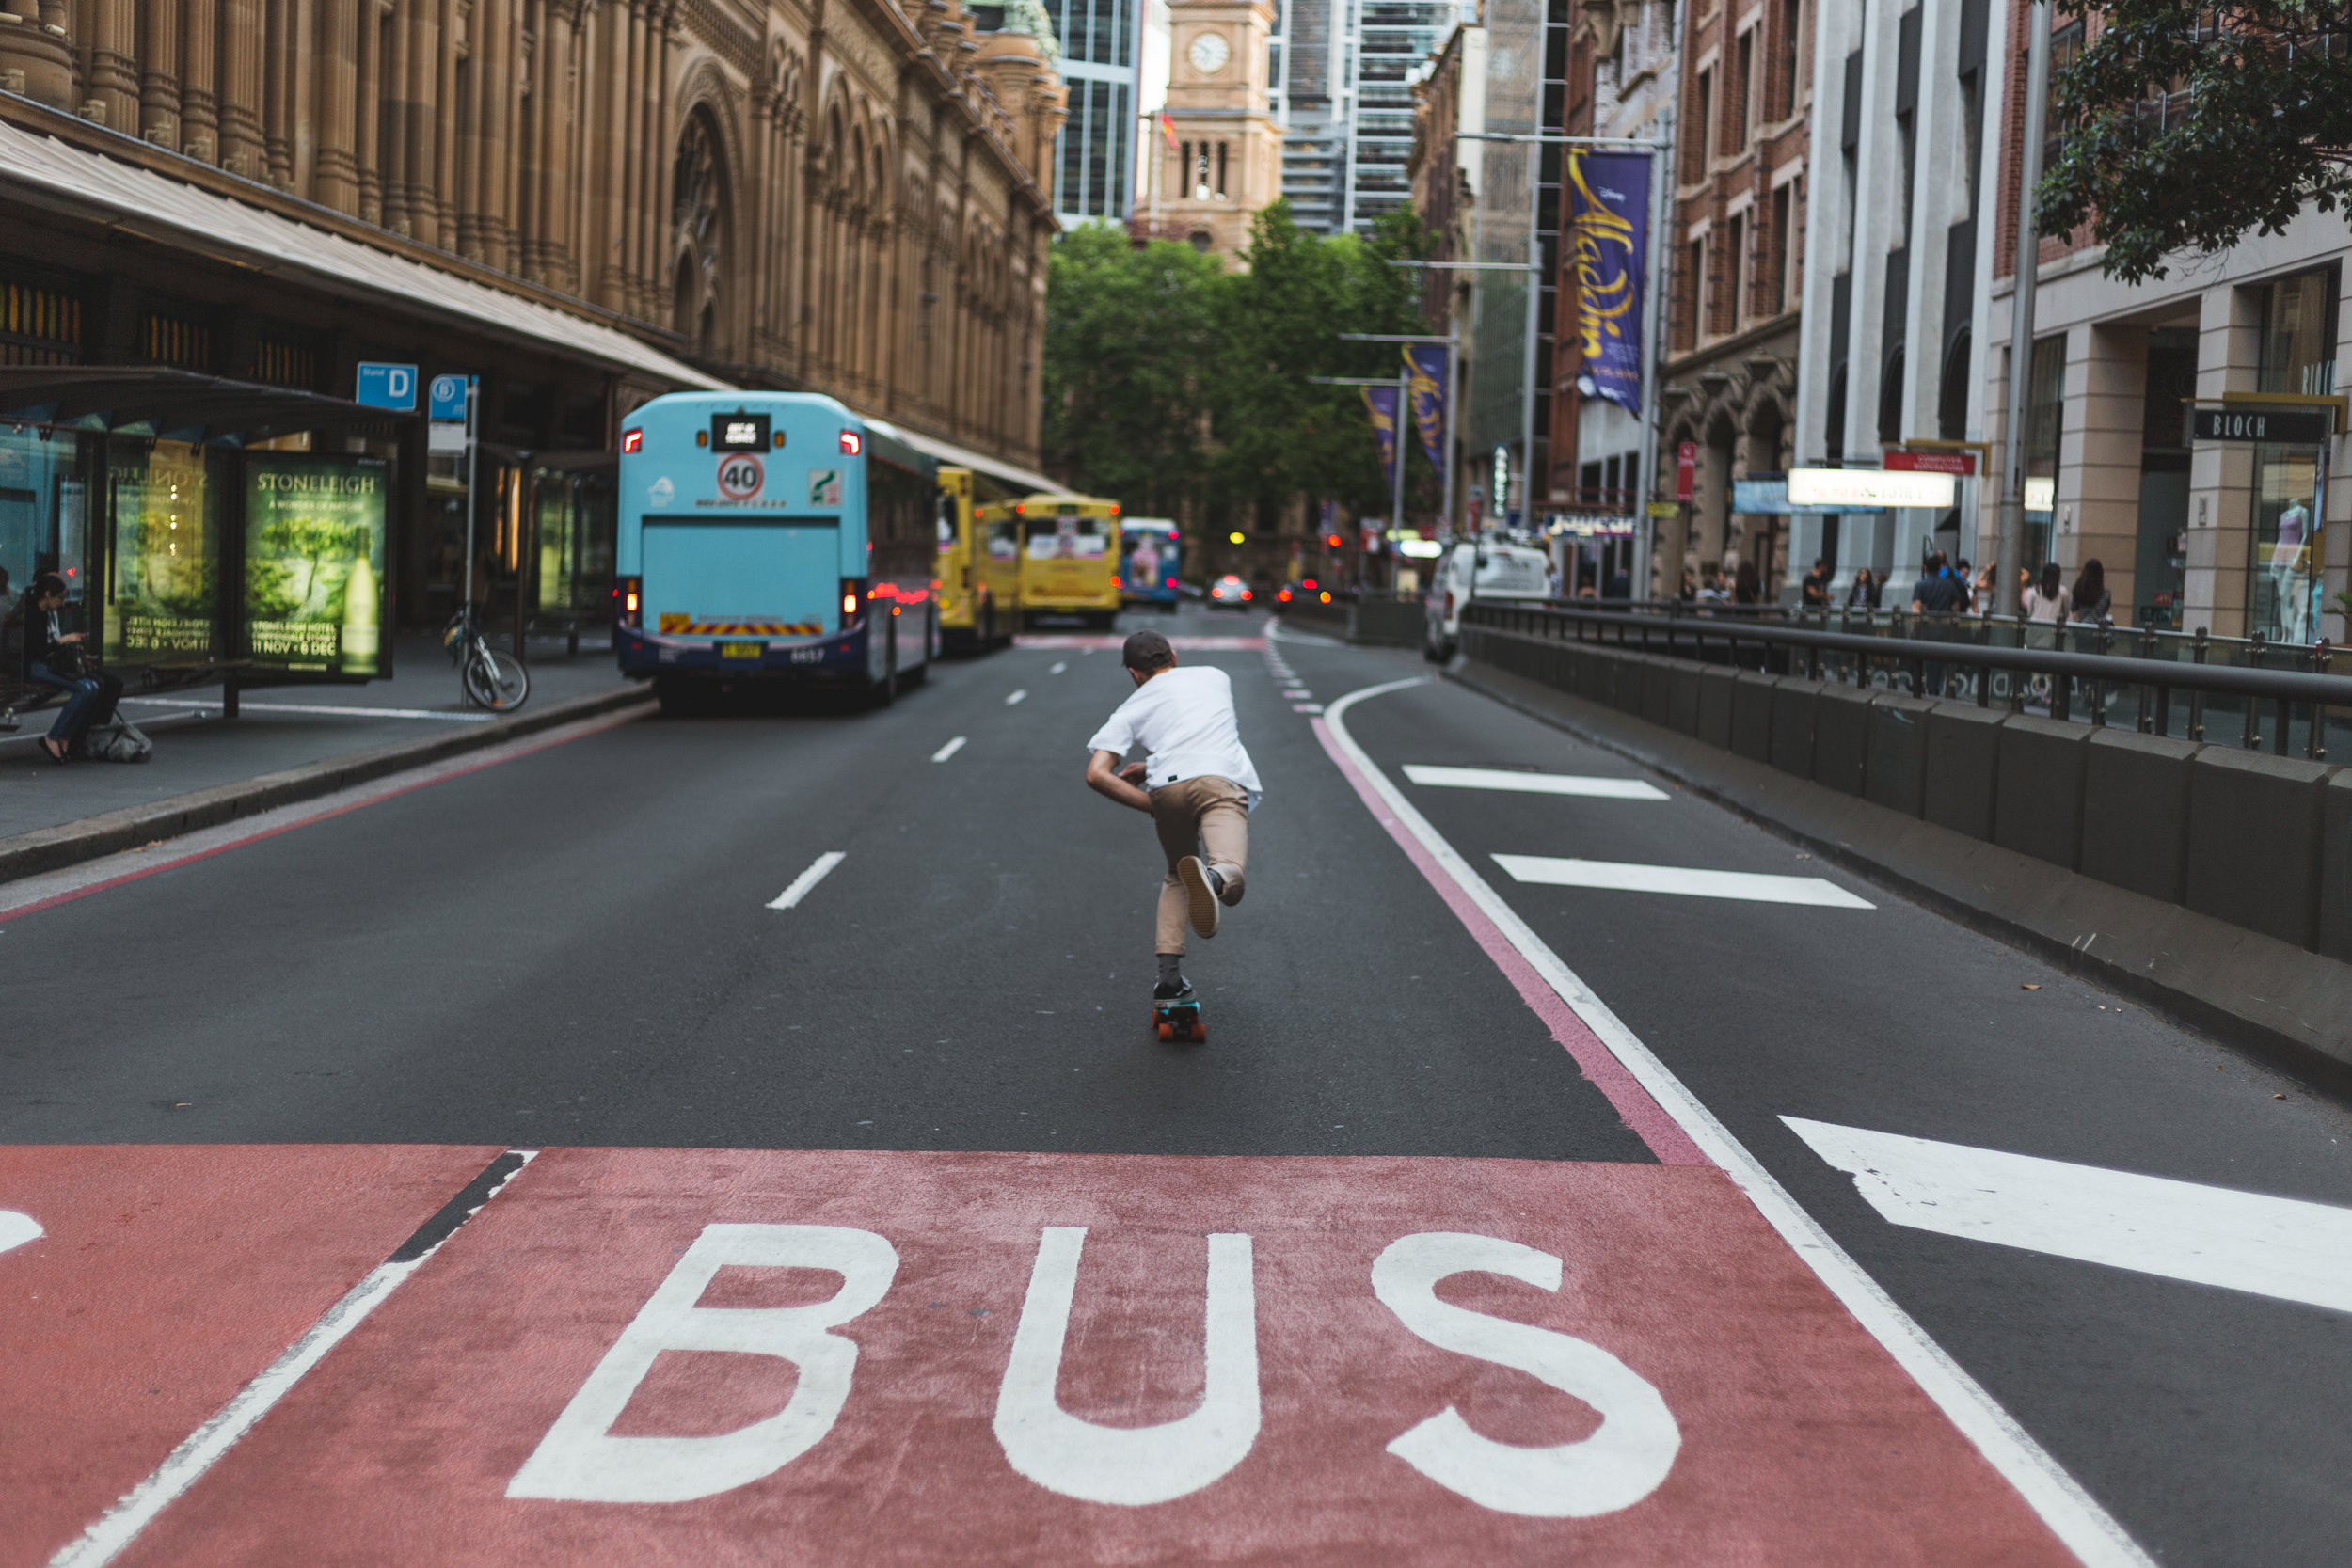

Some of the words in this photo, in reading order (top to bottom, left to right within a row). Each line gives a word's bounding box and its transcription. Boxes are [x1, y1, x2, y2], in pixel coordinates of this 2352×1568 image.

[389, 369, 409, 397] D
[2213, 415, 2265, 437] BLOCH
[258, 473, 374, 495] STONELEIGH
[723, 466, 756, 488] 40
[252, 640, 262, 654] 11
[263, 640, 291, 654] NOV
[310, 641, 337, 656] DEC
[504, 1221, 1681, 1518] BUS
